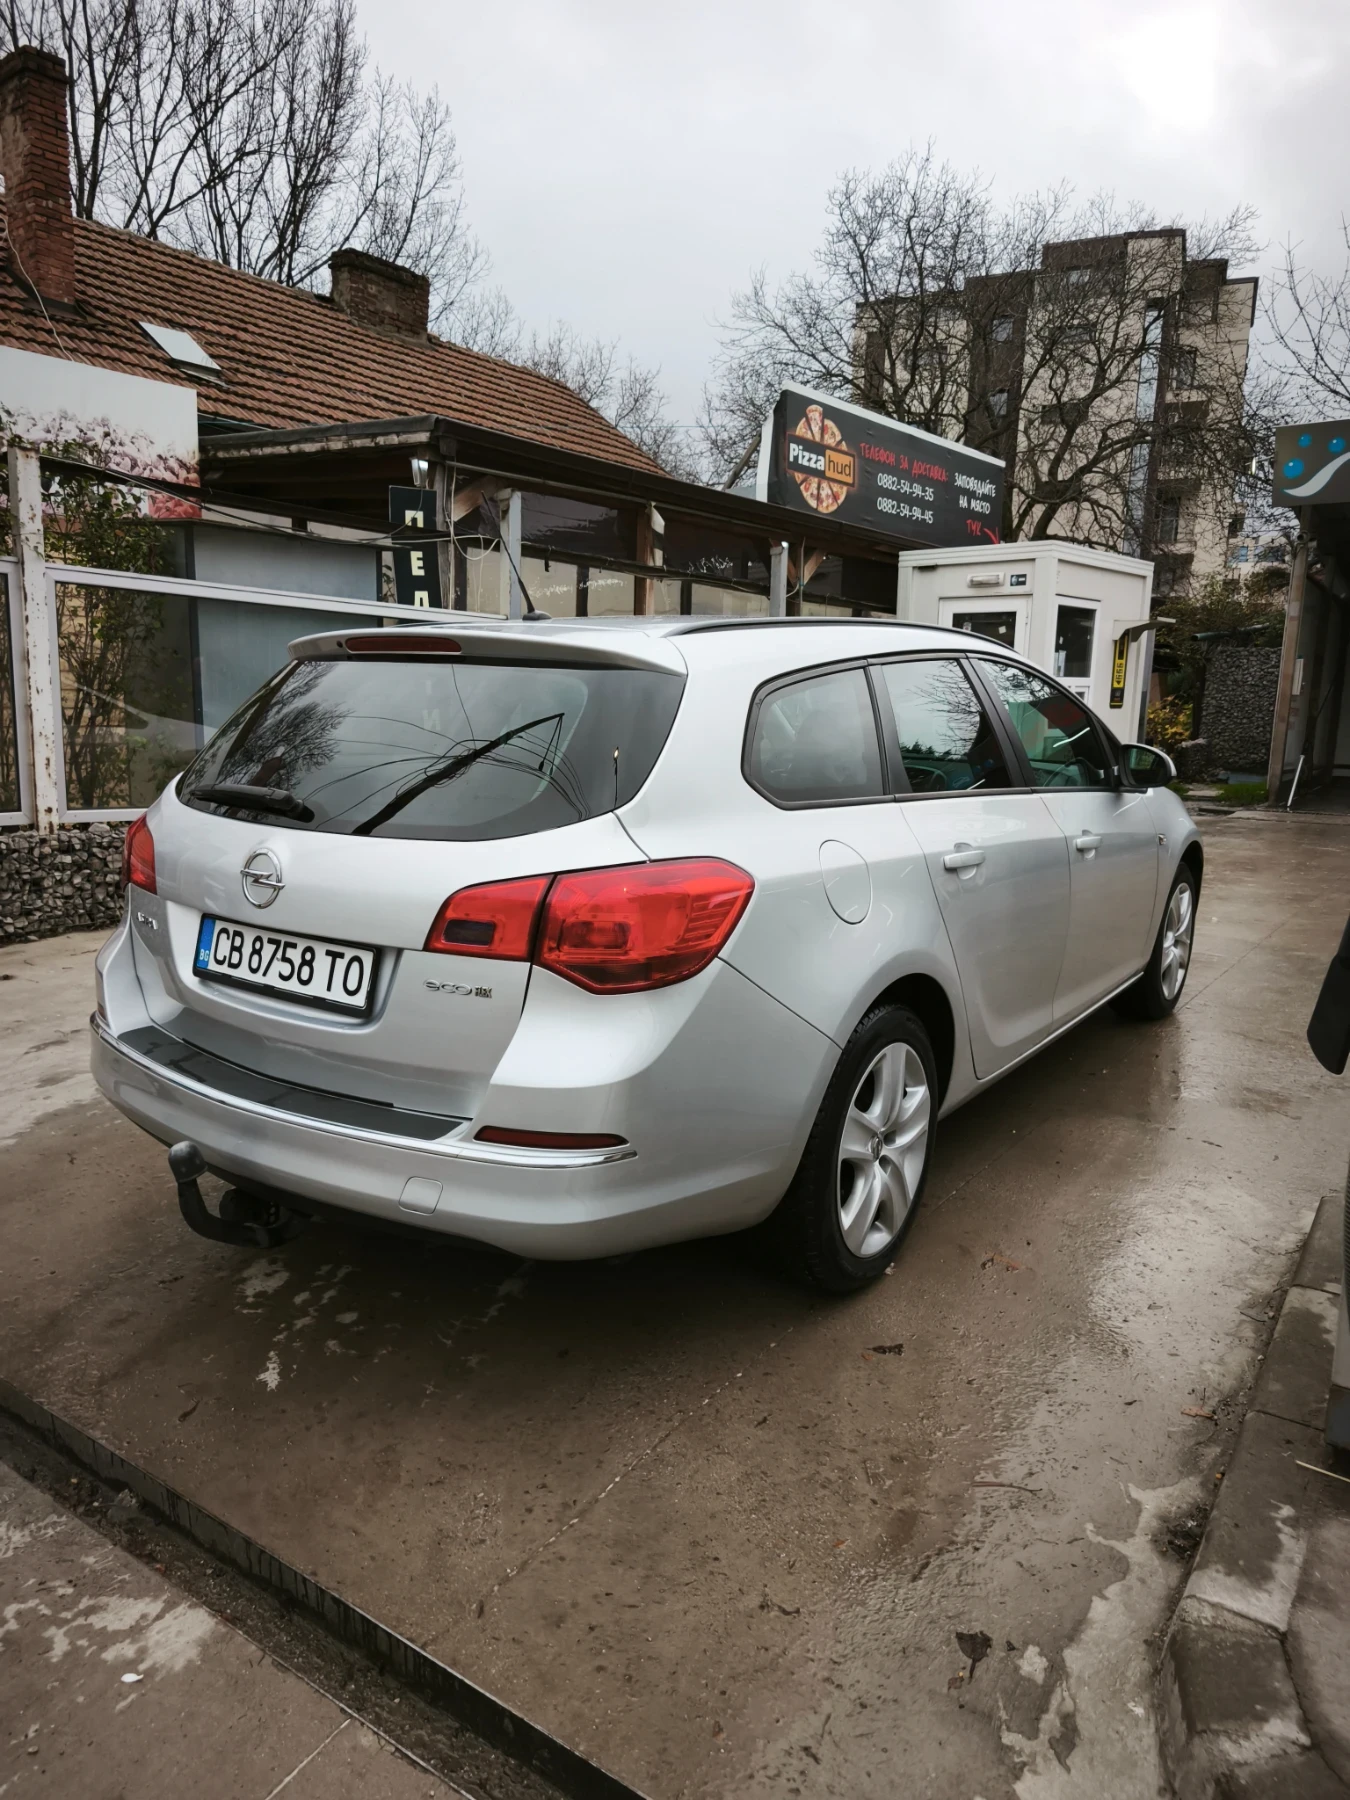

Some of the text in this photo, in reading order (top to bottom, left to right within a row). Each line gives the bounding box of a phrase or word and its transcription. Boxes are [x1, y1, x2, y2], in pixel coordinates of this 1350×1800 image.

[788, 443, 853, 477] Pizza hud
[860, 443, 896, 466] ТЕЛЕФОН
[899, 455, 909, 470] ЗА
[877, 473, 935, 502] 0882-54-94-35
[876, 497, 934, 525] 0882-54-94-45
[959, 495, 991, 515] НА МЯСТО
[966, 519, 981, 536] ТУК
[199, 948, 210, 962] BG
[247, 935, 316, 986] 8758
